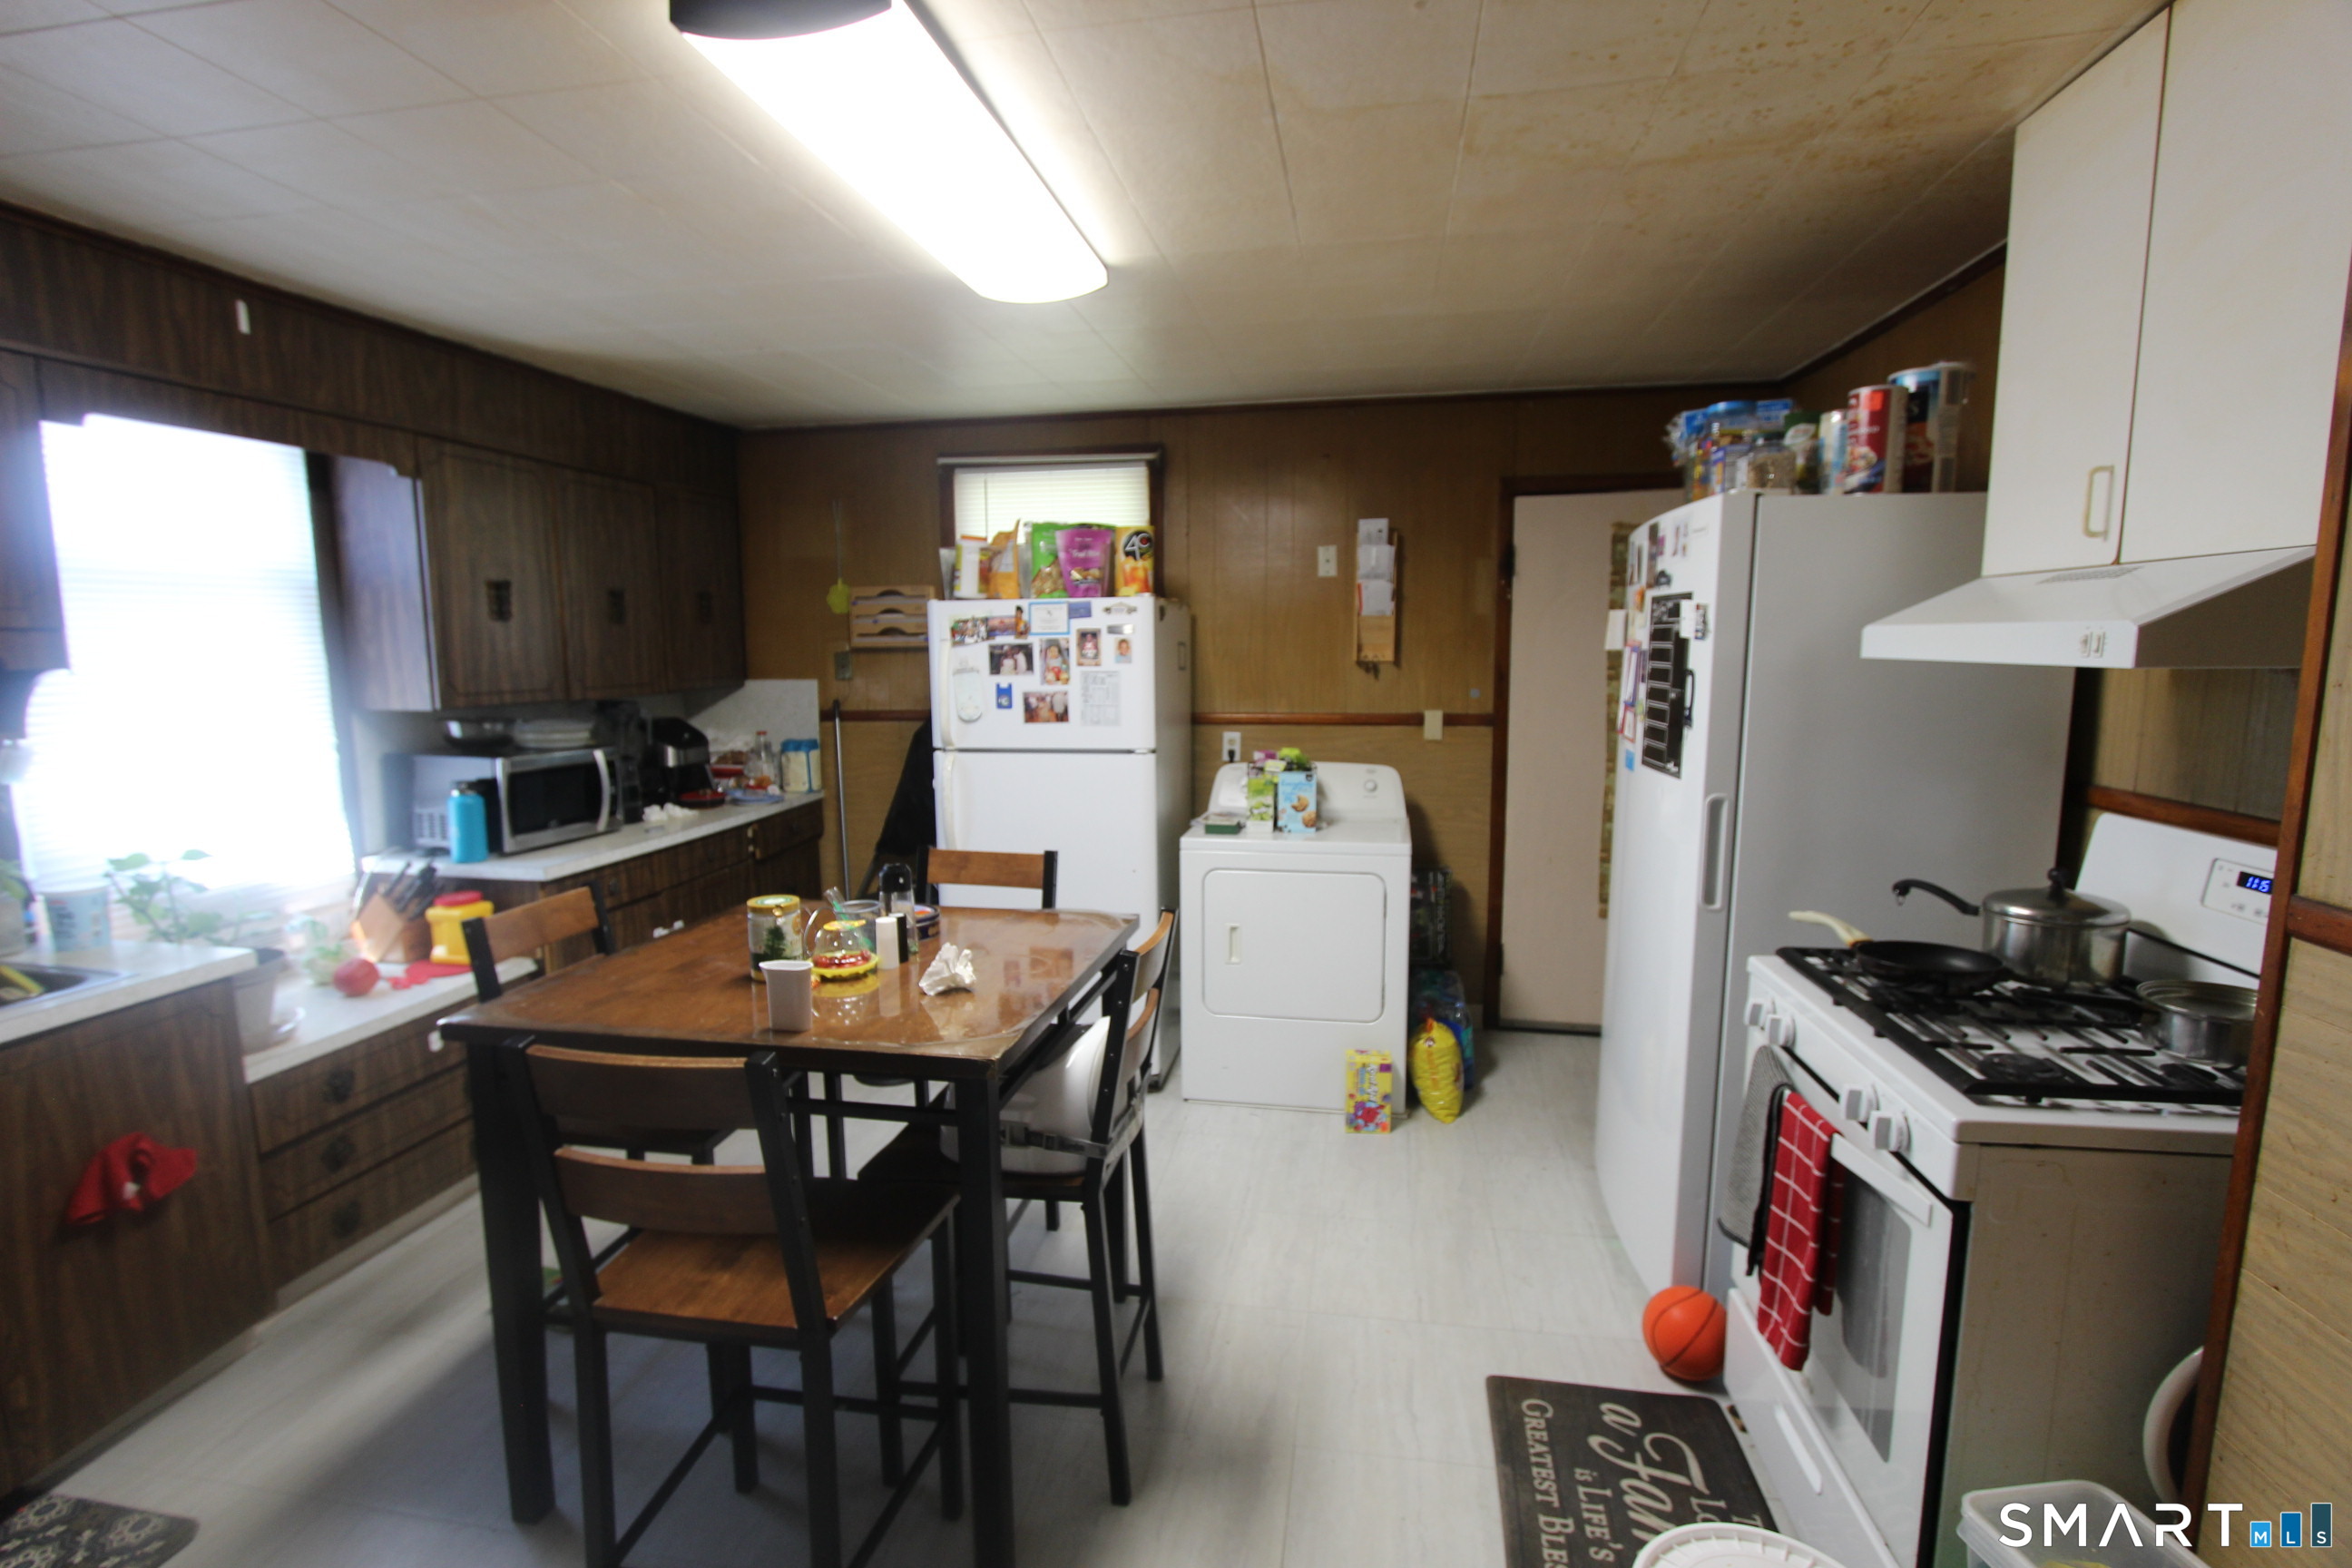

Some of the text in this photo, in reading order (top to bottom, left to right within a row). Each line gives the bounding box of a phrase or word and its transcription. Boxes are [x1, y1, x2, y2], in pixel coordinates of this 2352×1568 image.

[1520, 1398, 1561, 1509] GREATEST
[1587, 1402, 1710, 1542] a Fam
[1573, 1466, 1624, 1563] is LIFE'S
